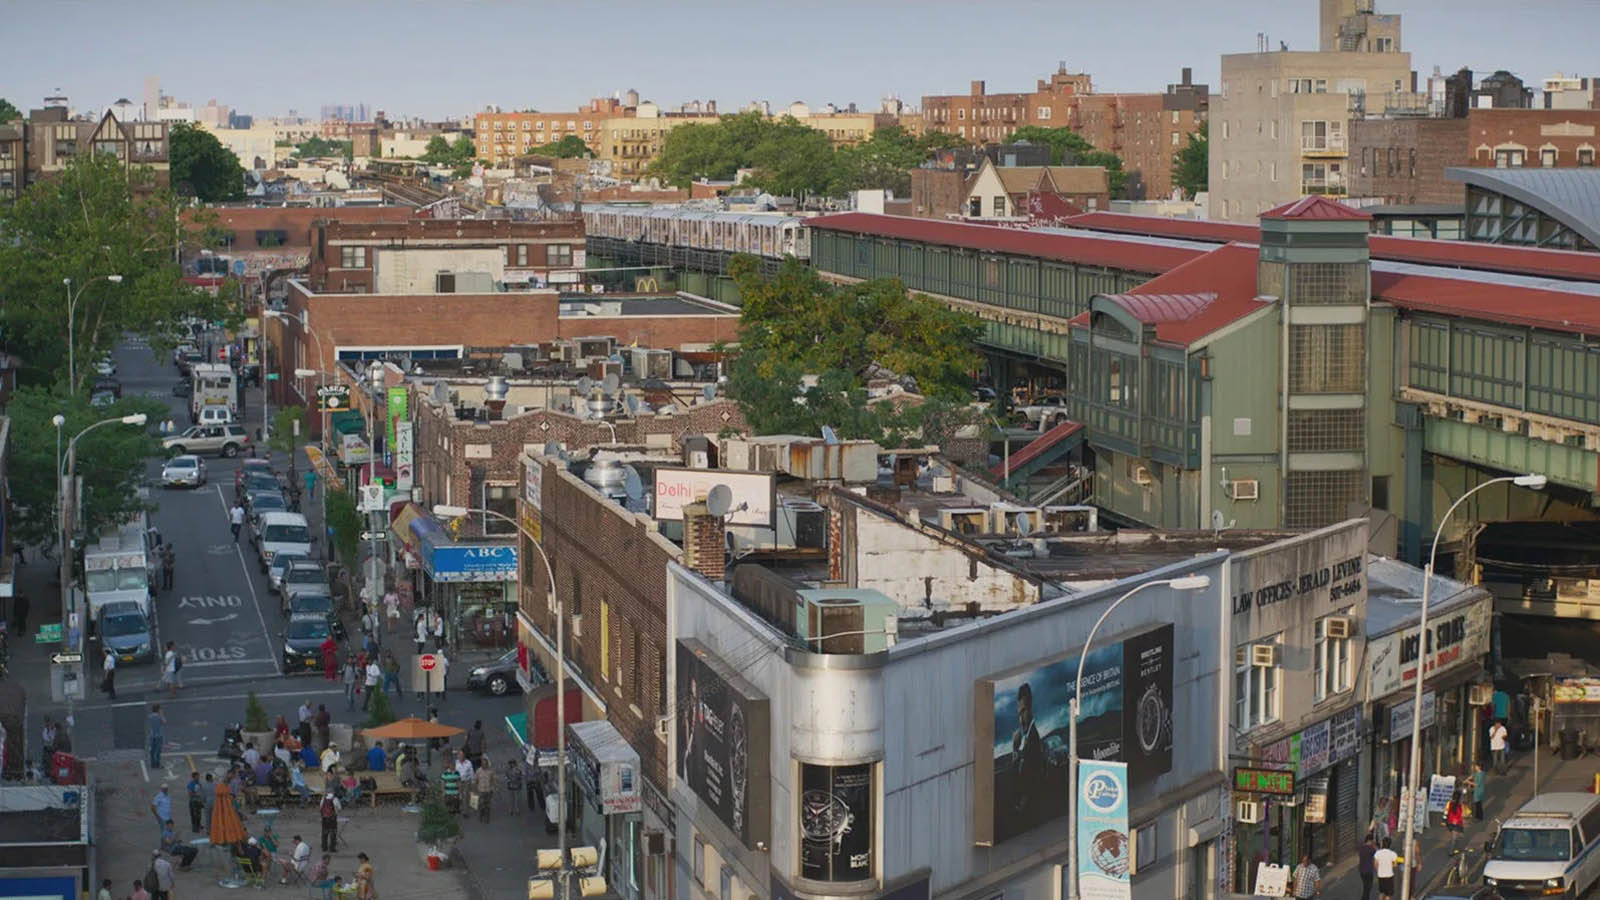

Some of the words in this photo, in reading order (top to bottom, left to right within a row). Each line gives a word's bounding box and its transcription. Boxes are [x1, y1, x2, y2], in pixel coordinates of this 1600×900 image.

[657, 481, 692, 497] Delhi
[1232, 591, 1253, 615] LAW
[1256, 580, 1292, 608] OFFICES
[1296, 567, 1329, 595] JERALD
[1332, 555, 1362, 582] LEVINE
[178, 594, 242, 608] ONLY
